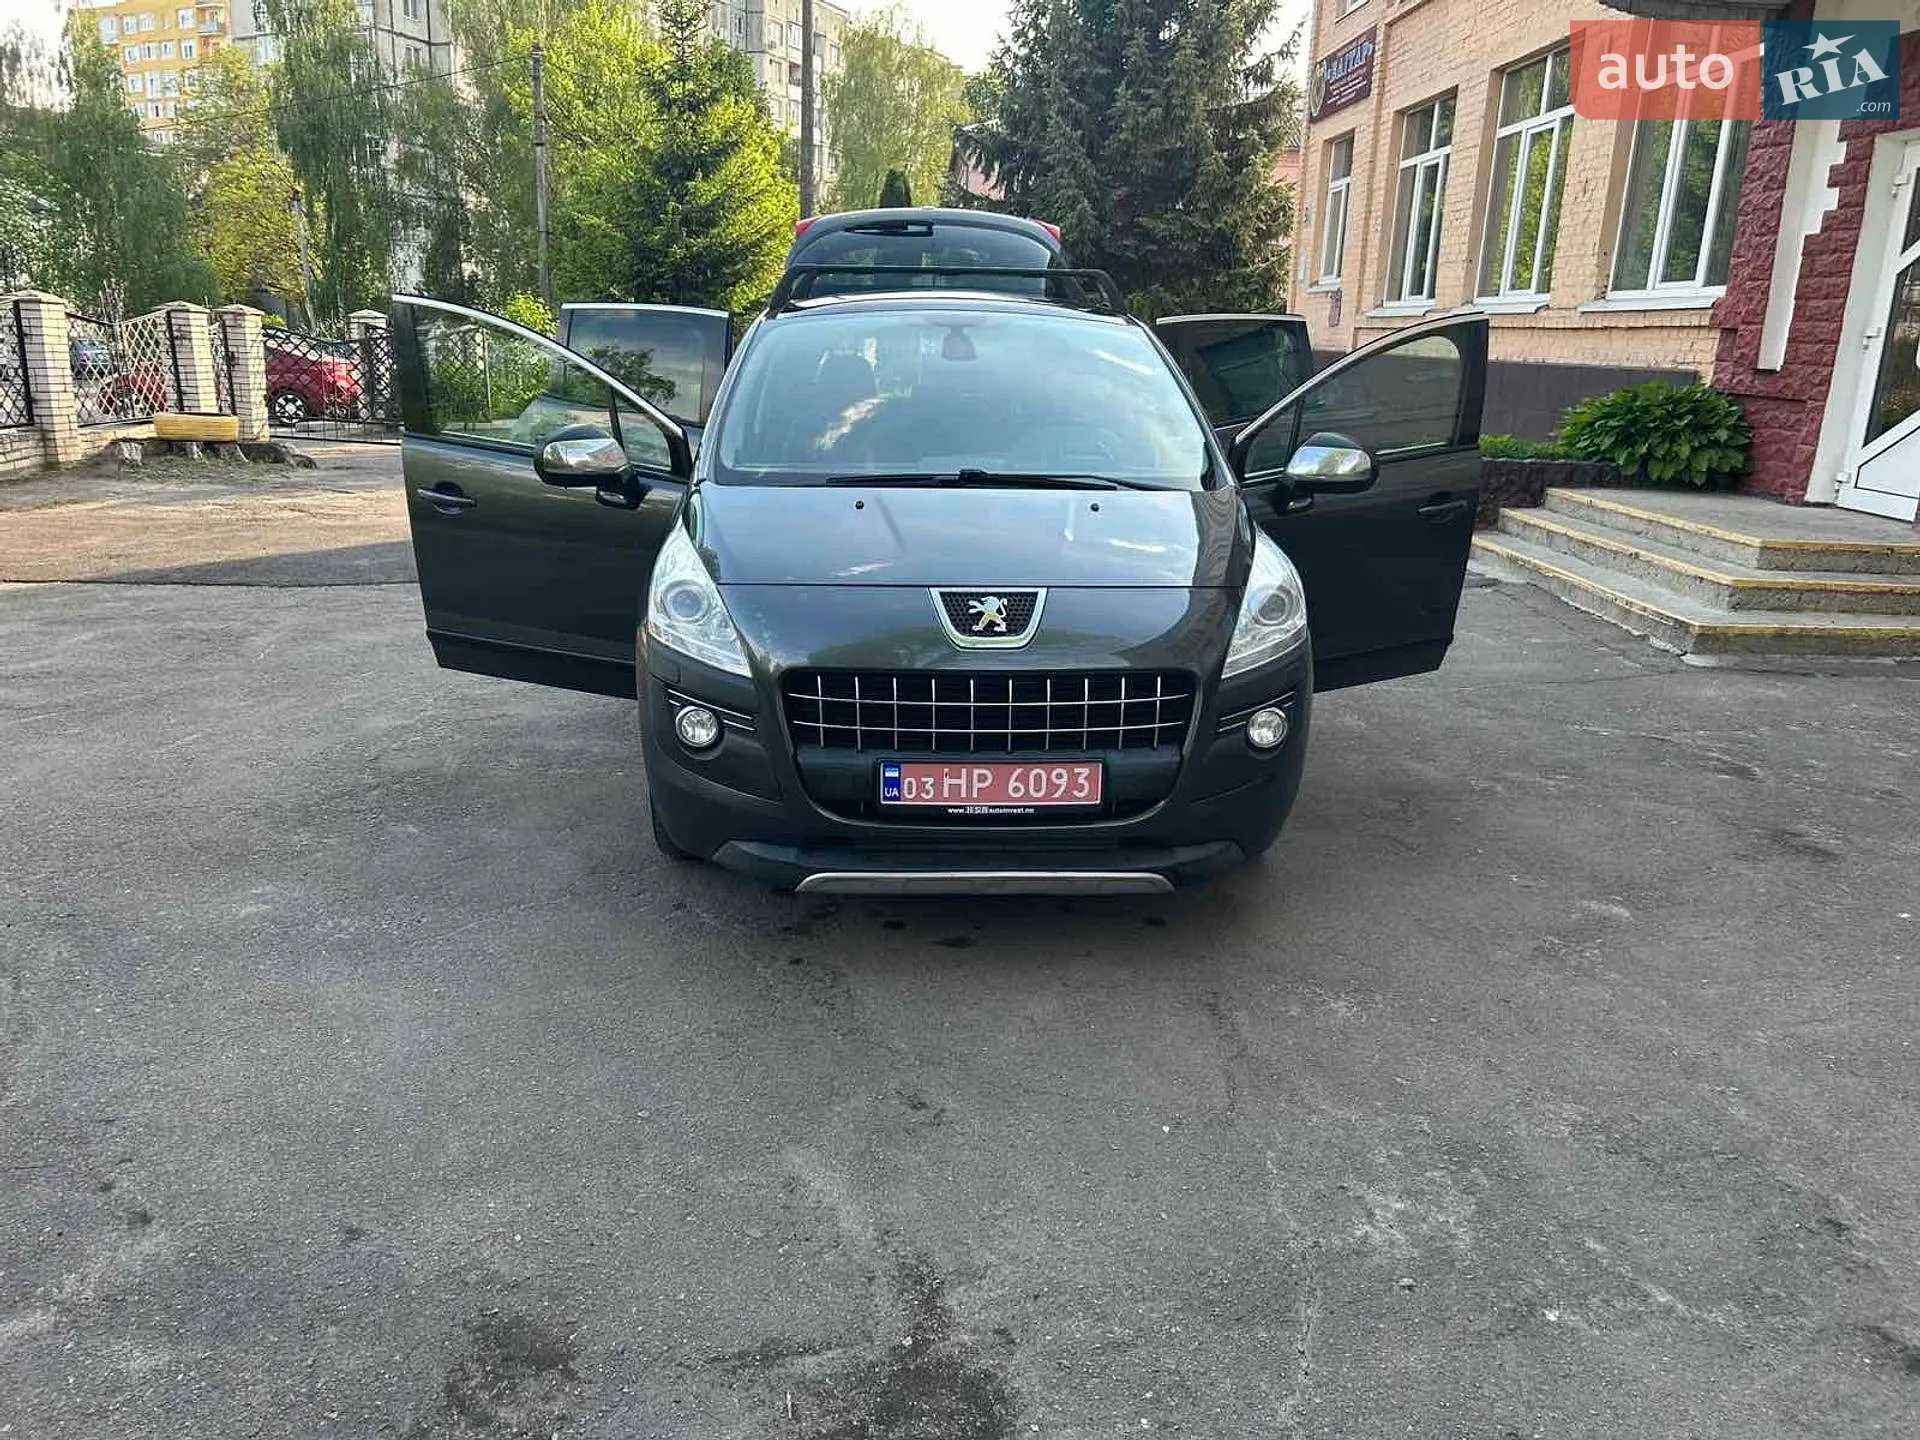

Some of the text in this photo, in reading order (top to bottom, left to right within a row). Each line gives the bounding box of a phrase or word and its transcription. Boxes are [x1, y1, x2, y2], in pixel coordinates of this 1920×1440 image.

[884, 786, 899, 798] UA
[903, 767, 1090, 799] 03 HP 6093
